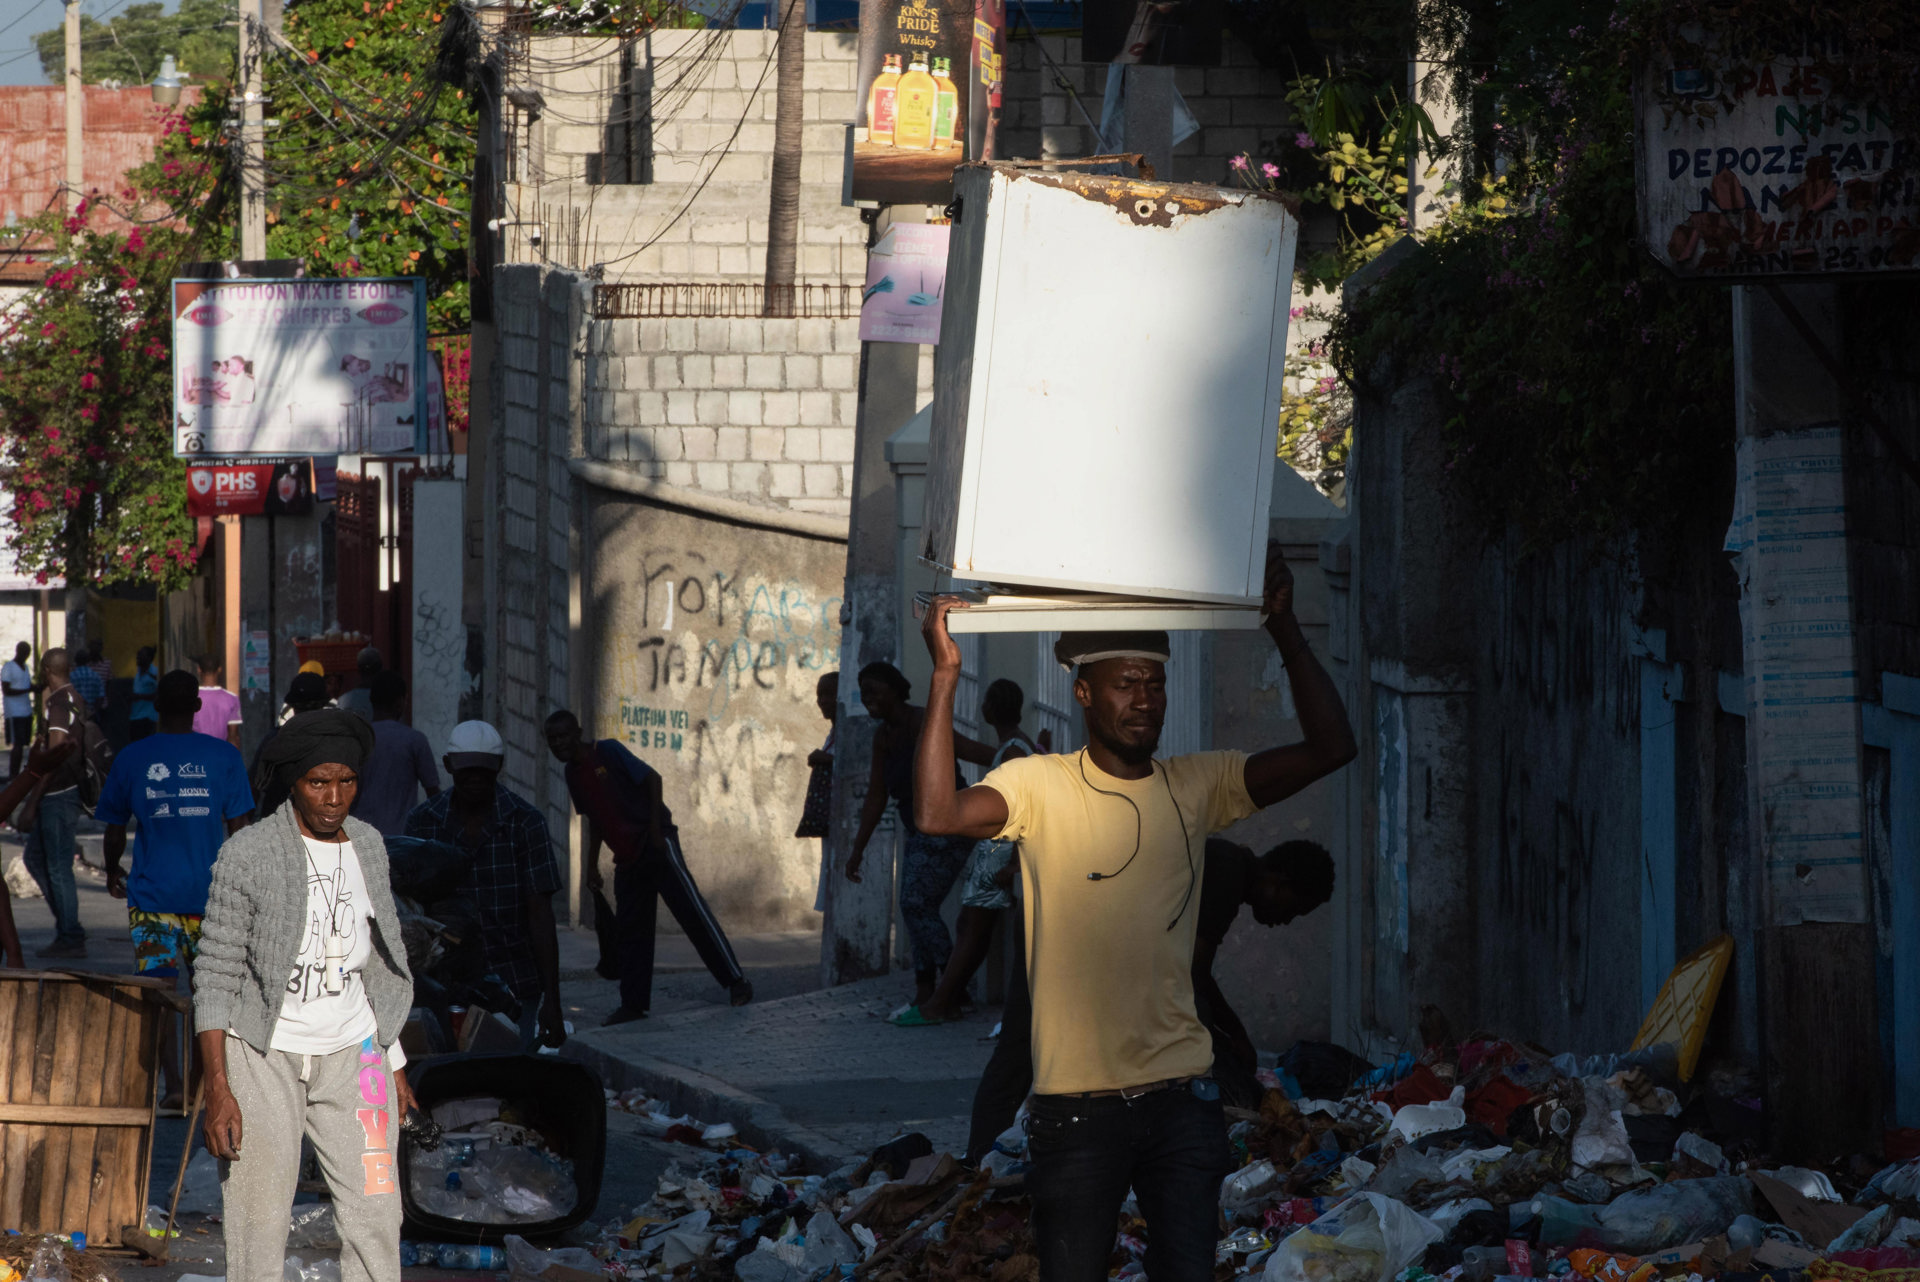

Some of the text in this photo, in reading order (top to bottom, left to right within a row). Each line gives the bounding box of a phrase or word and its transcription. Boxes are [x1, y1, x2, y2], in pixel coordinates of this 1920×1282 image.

[901, 5, 939, 19] KING'S
[897, 16, 940, 34] PRIDE
[900, 34, 937, 49] Whisky
[1668, 145, 1808, 181] DEPOZE
[293, 284, 342, 300] MIXTE
[273, 307, 351, 324] CHIFFRES
[216, 472, 256, 491] PHS
[178, 762, 207, 776] XCEL
[179, 787, 209, 795] MONEY
[356, 1034, 395, 1196] LOVE
